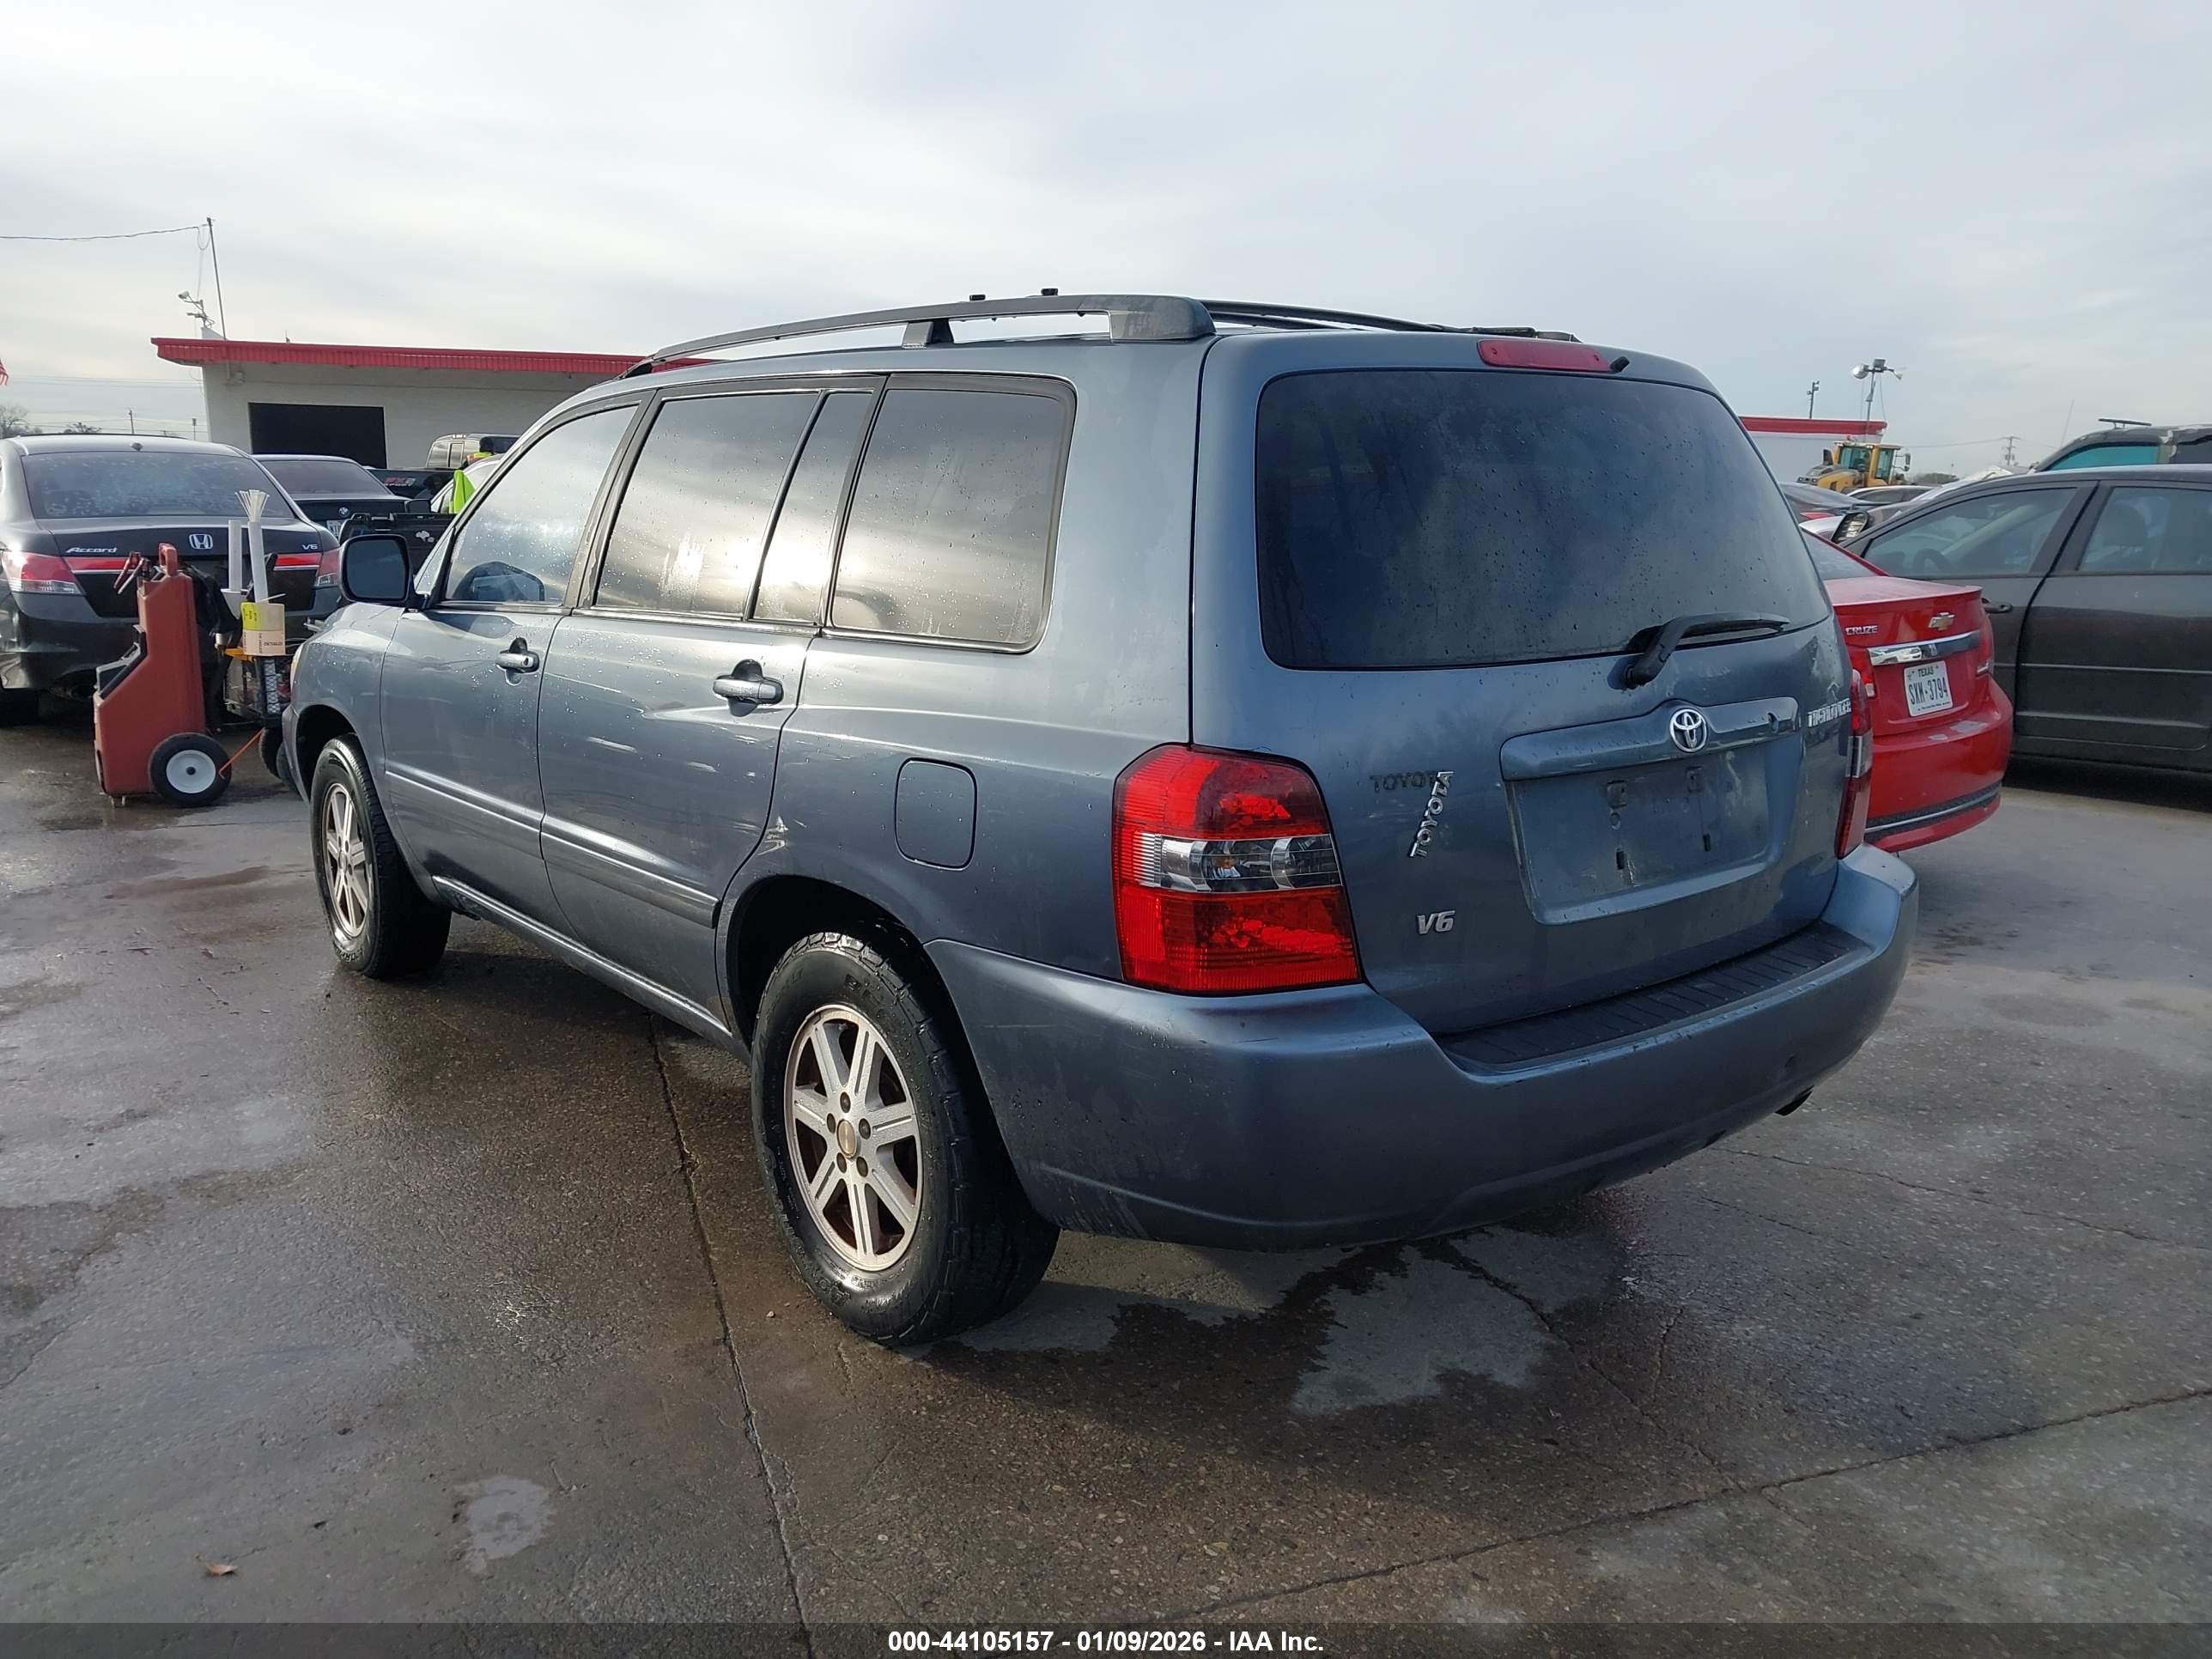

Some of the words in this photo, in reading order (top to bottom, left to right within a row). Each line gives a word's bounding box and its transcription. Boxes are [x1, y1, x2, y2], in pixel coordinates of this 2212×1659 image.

[1844, 625, 1878, 635] CRUZE
[1917, 666, 1934, 678] TEXAS
[1409, 771, 1454, 858] TOYOTA
[1417, 910, 1455, 935] V6
